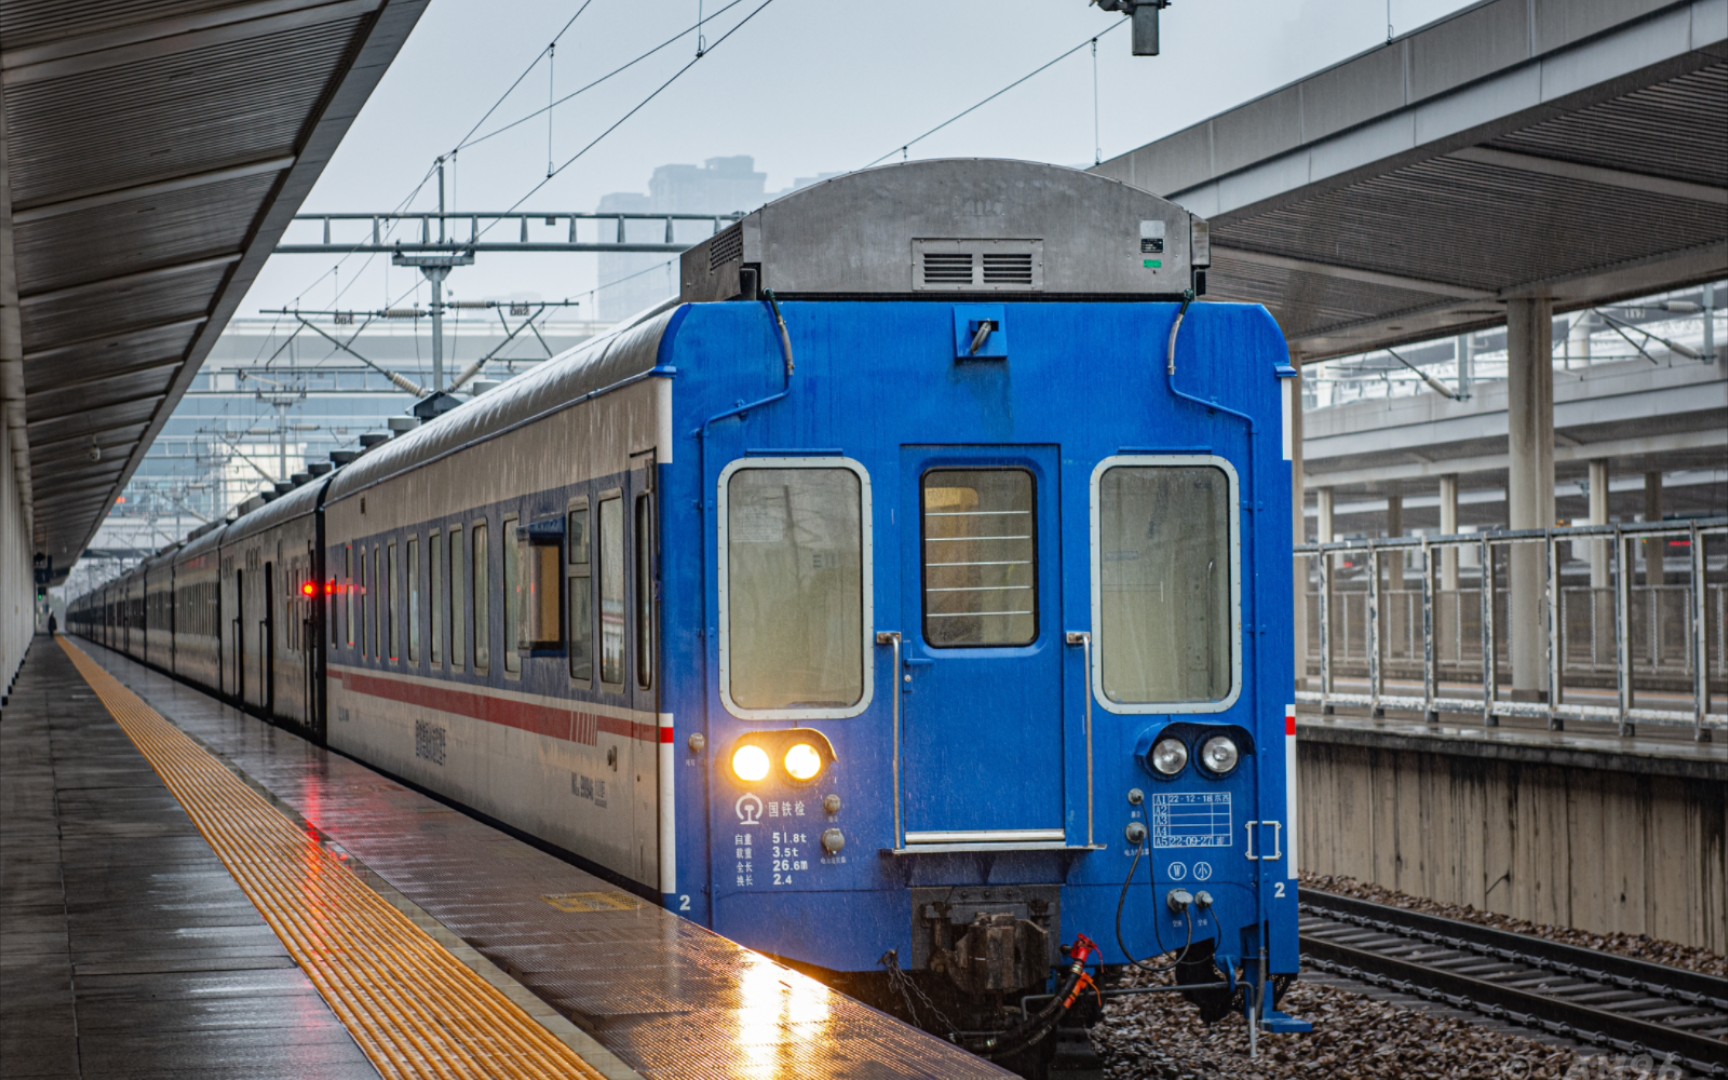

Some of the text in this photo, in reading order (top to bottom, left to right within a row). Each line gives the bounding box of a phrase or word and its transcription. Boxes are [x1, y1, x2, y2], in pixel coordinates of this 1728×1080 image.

[1156, 795, 1166, 805] A1
[768, 801, 806, 818] 国铁检
[1156, 806, 1168, 815] A2
[1156, 816, 1168, 826] A3
[735, 832, 807, 846] 自重 51.8t
[1156, 837, 1168, 847] A5
[772, 846, 799, 858] 3.5t
[736, 861, 753, 873] 全长
[772, 860, 808, 872] 26.6m
[736, 874, 793, 887] 换长 2.4
[1274, 882, 1286, 898] 2
[679, 894, 691, 911] 2
